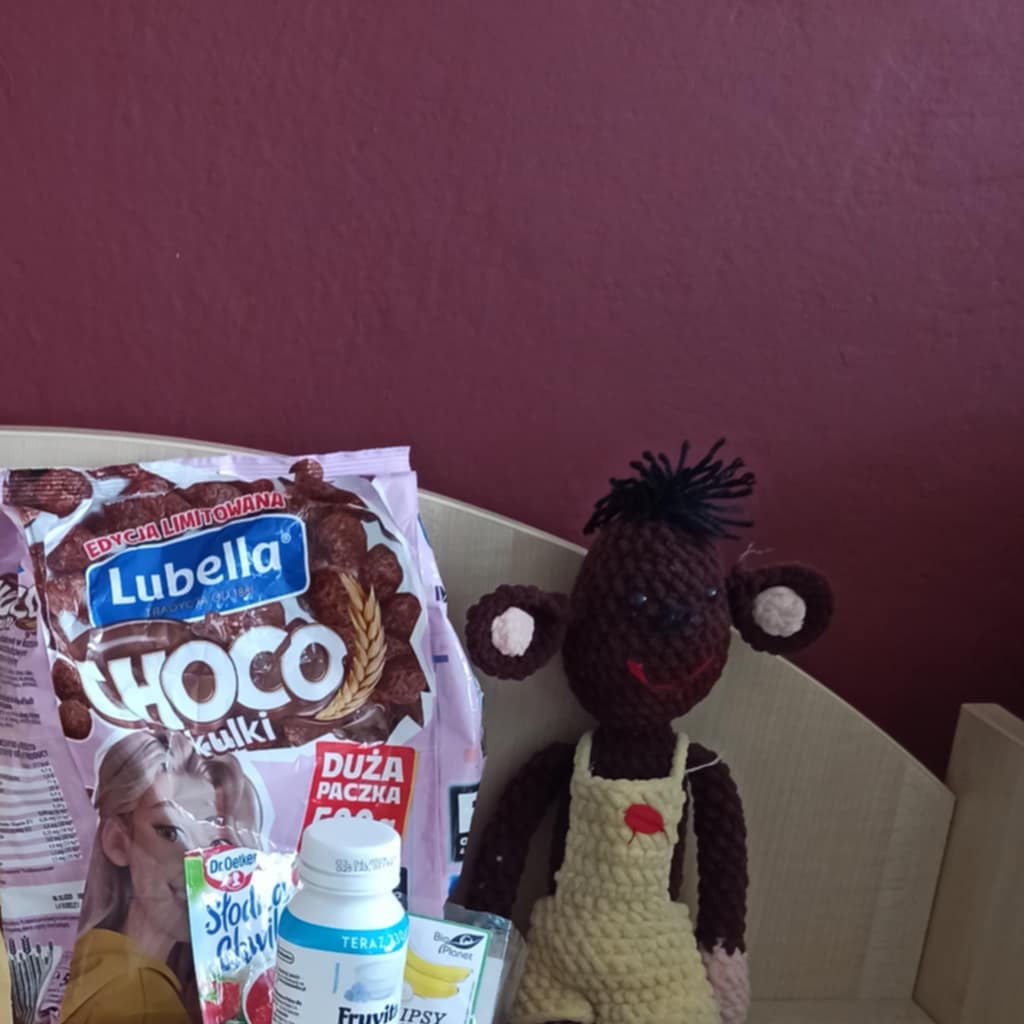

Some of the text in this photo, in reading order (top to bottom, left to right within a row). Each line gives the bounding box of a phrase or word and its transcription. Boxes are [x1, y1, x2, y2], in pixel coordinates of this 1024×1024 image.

[84, 492, 286, 560] EDYCJA LIMITOWANA
[108, 536, 282, 605] Lubella
[75, 624, 348, 731] CHOCO
[185, 711, 277, 759] kulki
[321, 748, 404, 783] DUŻA
[316, 781, 401, 805] PACZKA
[433, 931, 450, 946] Bio
[438, 945, 473, 961] Planet
